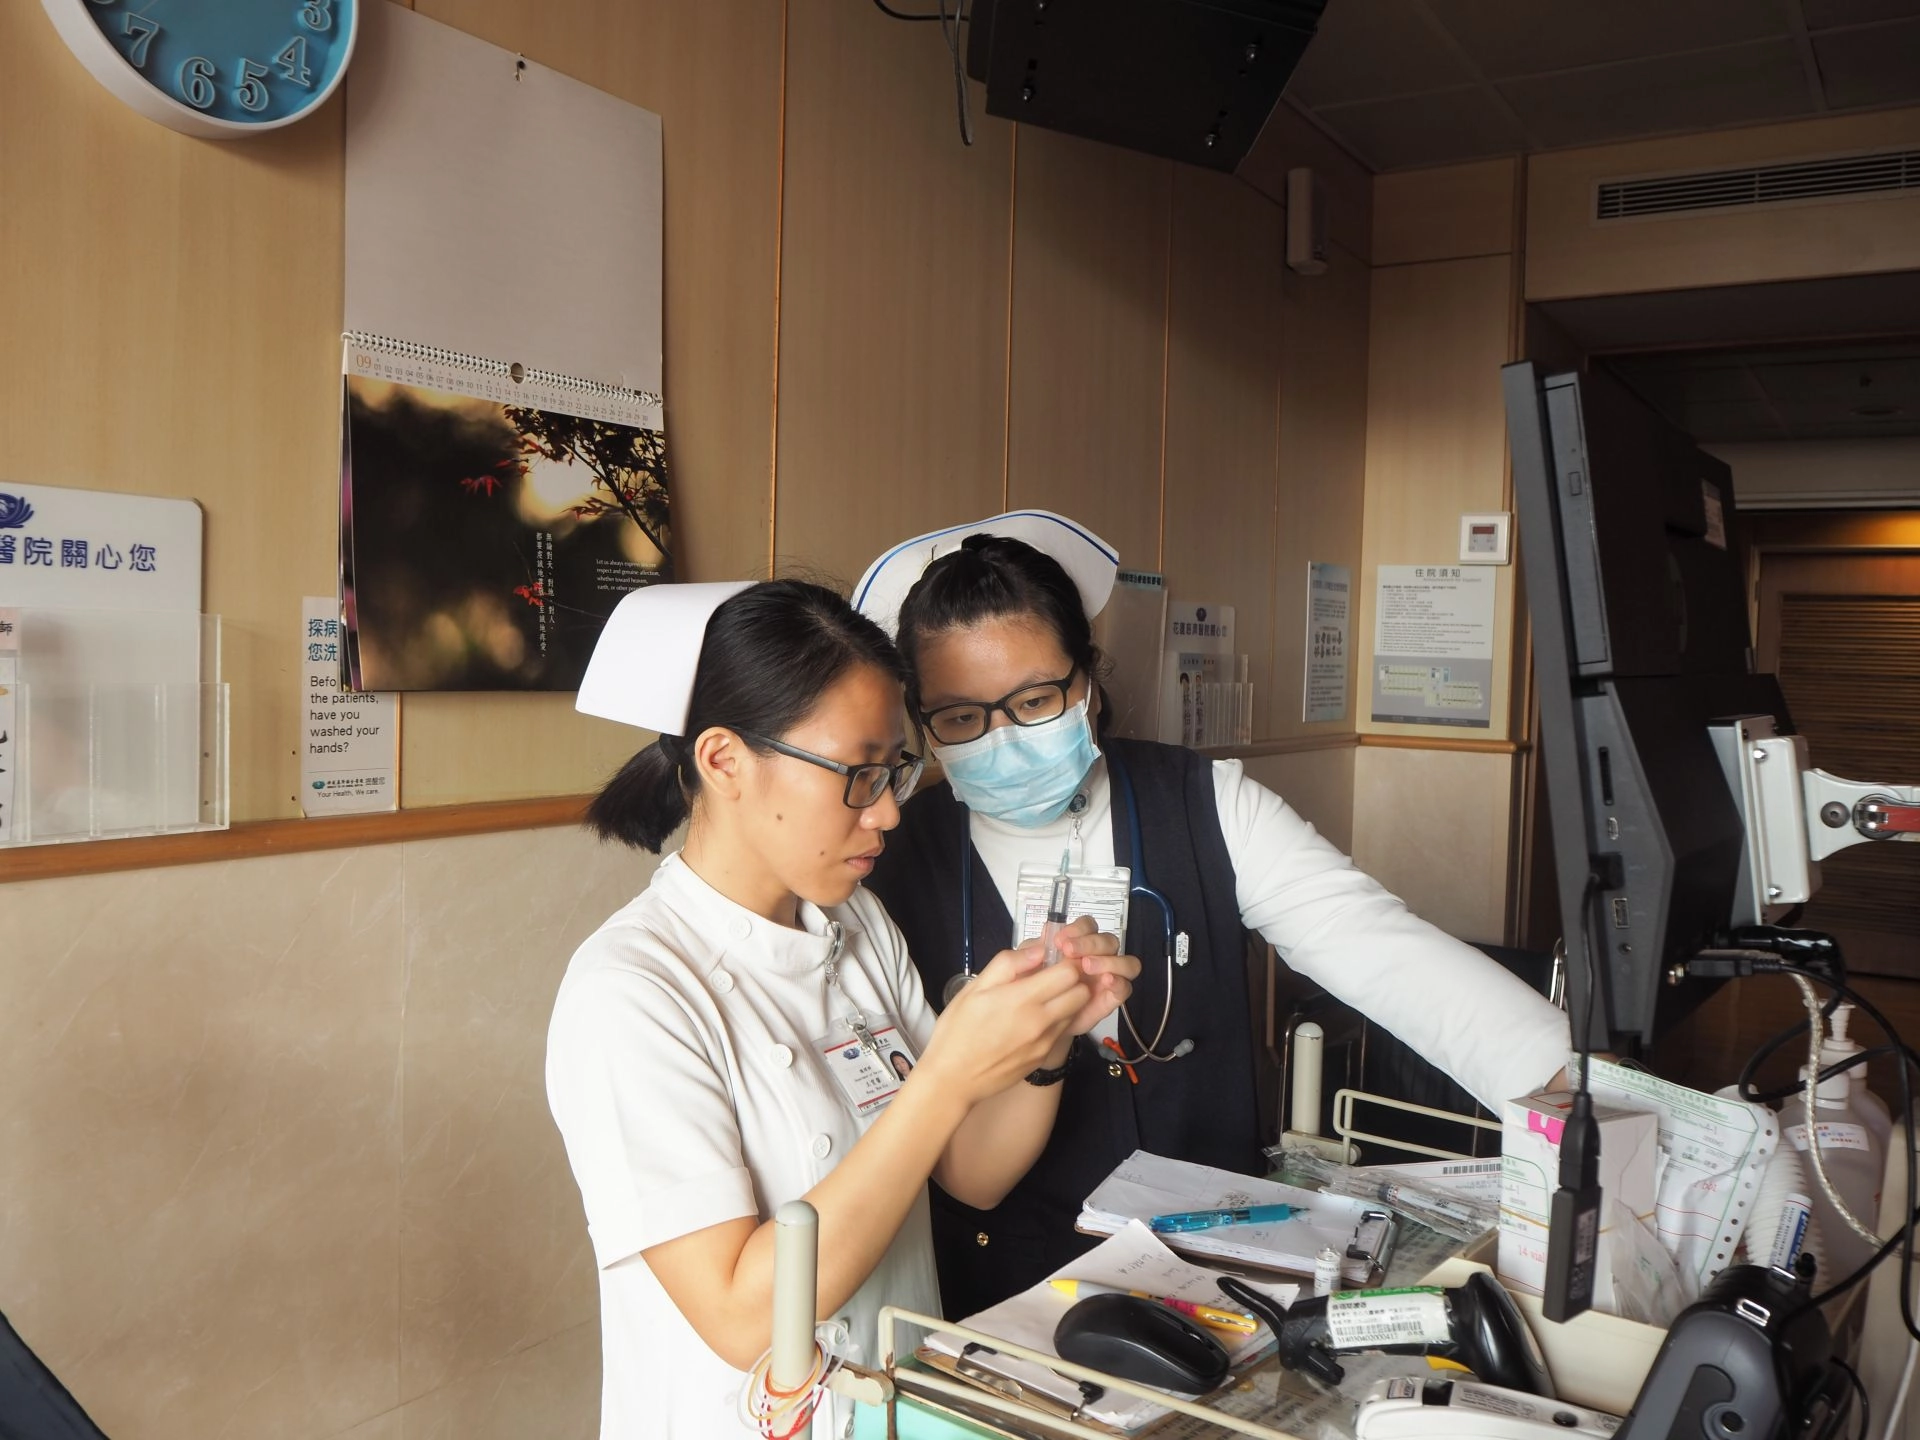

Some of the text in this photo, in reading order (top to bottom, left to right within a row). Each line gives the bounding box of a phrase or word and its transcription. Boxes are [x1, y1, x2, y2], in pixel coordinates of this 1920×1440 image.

[301, 0, 332, 31] 3
[124, 11, 160, 69] 7
[276, 35, 311, 88] 4
[179, 56, 216, 109] 6
[237, 58, 270, 112] 5
[356, 354, 372, 369] 09
[0, 534, 156, 572] 醫院關心您
[1415, 568, 1460, 577] 住院須知
[308, 619, 337, 639] 探病
[308, 643, 336, 661] 您洗
[310, 693, 379, 706] the patients,
[310, 711, 360, 723] have you
[310, 726, 379, 739] washed your
[310, 742, 349, 754] hands?
